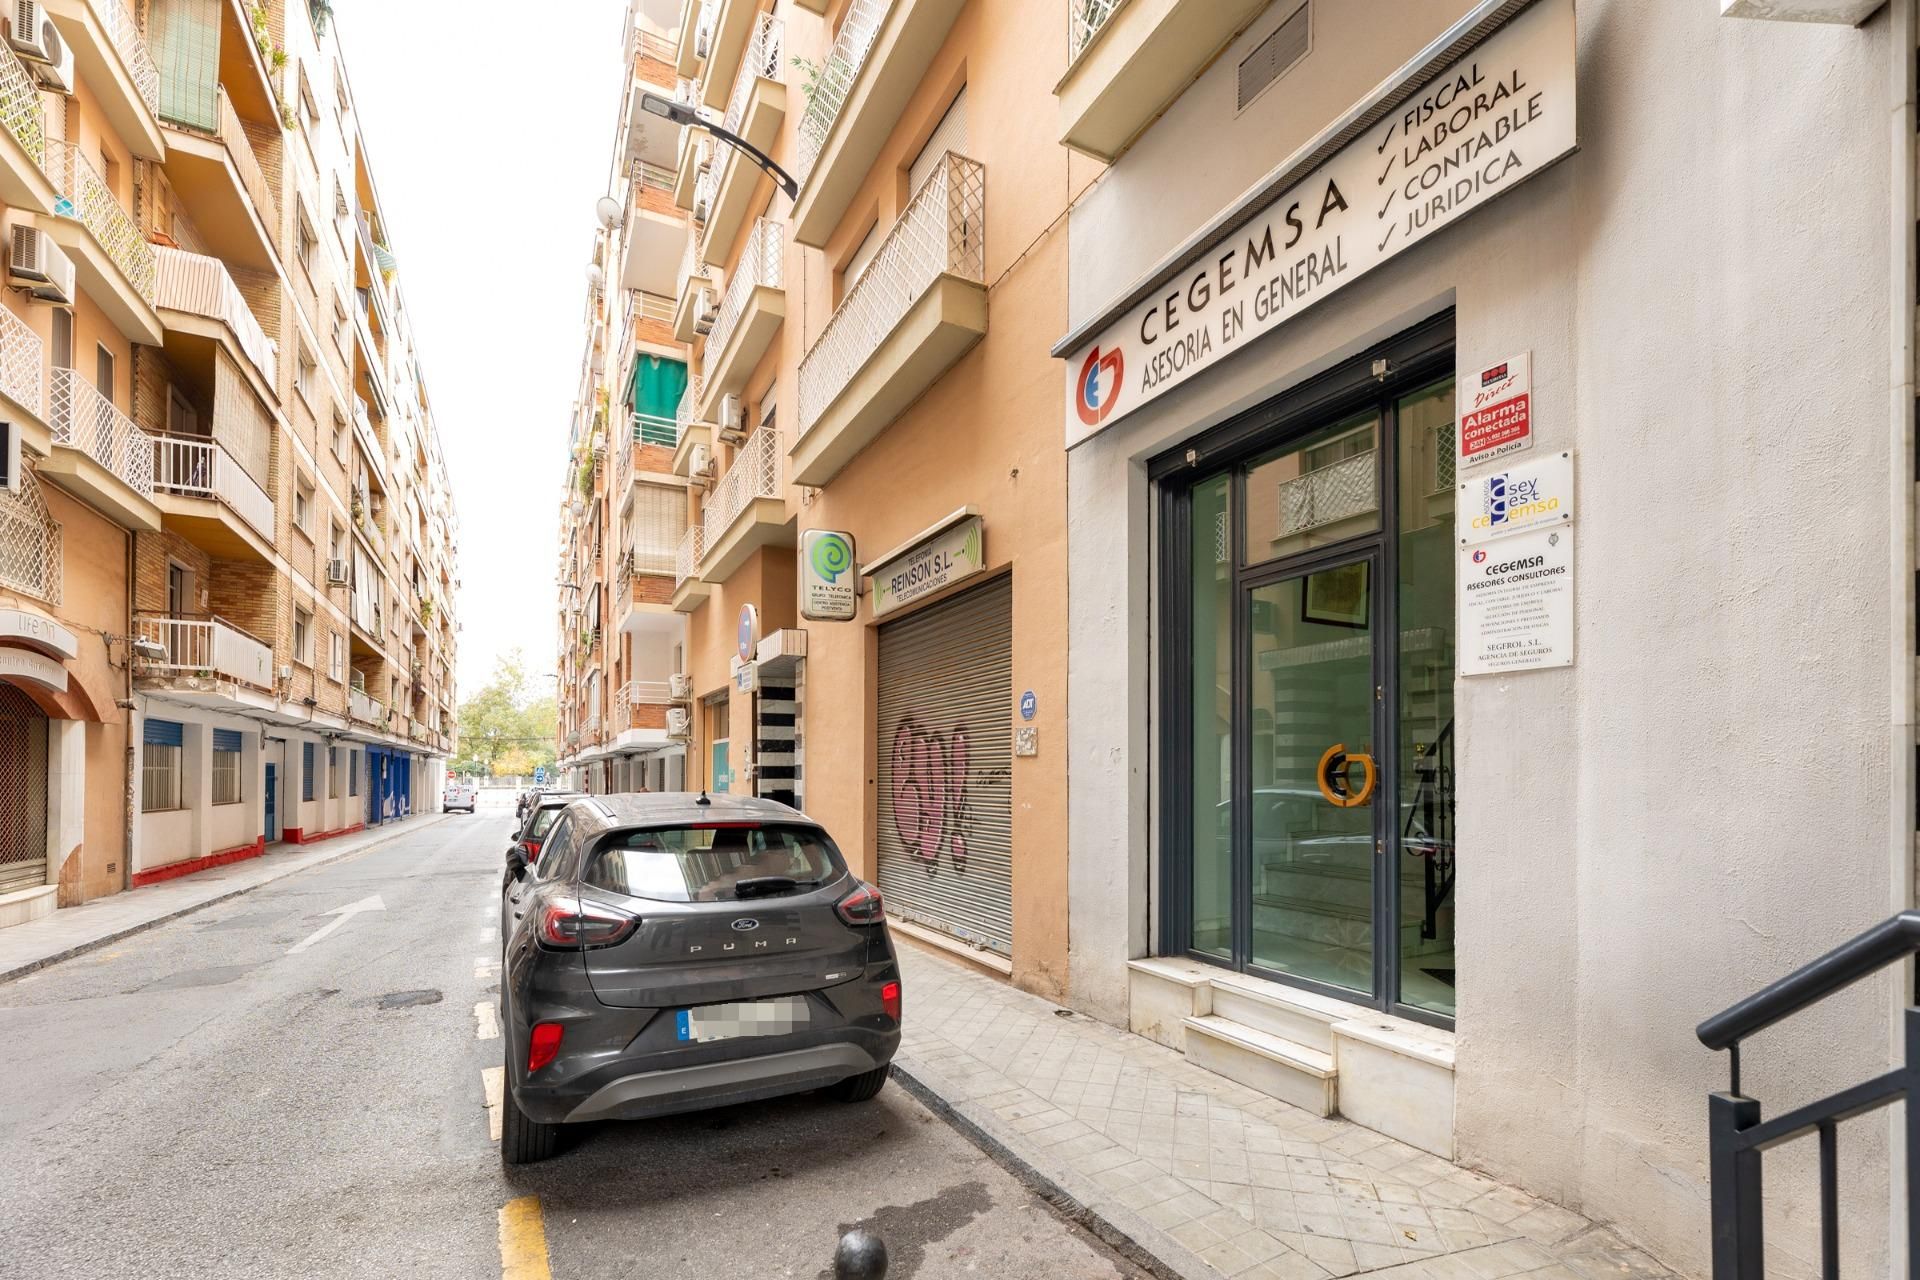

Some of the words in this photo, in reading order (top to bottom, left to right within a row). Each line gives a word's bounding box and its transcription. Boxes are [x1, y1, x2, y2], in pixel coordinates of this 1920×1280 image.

[1404, 63, 1485, 136] FISCAL
[1404, 69, 1526, 169] LABORAL
[1404, 91, 1543, 201] CONTABLE
[1404, 149, 1523, 237] JURIDICA
[1140, 177, 1349, 345] CEGEMSA
[1141, 325, 1212, 394] ASESORIA
[1222, 300, 1244, 345] EN
[1254, 235, 1348, 322] GENERAL
[1473, 373, 1520, 409] Direct
[1464, 399, 1526, 430] Alarma
[1464, 412, 1527, 440] conectada
[1469, 453, 1490, 464] Aviso
[891, 559, 931, 595] REINSON
[934, 551, 953, 574] S.L.
[1466, 578, 1505, 592] ASESORES
[1507, 565, 1566, 584] CONSULTORES
[1485, 555, 1544, 576] CEGEMSA
[811, 585, 852, 593] TELYCO
[1477, 650, 1508, 661] AGENCIA
[1508, 649, 1518, 658] DE
[1518, 646, 1553, 657] SEGUROS
[1022, 698, 1034, 710] ADT
[690, 937, 797, 953] PUMA
